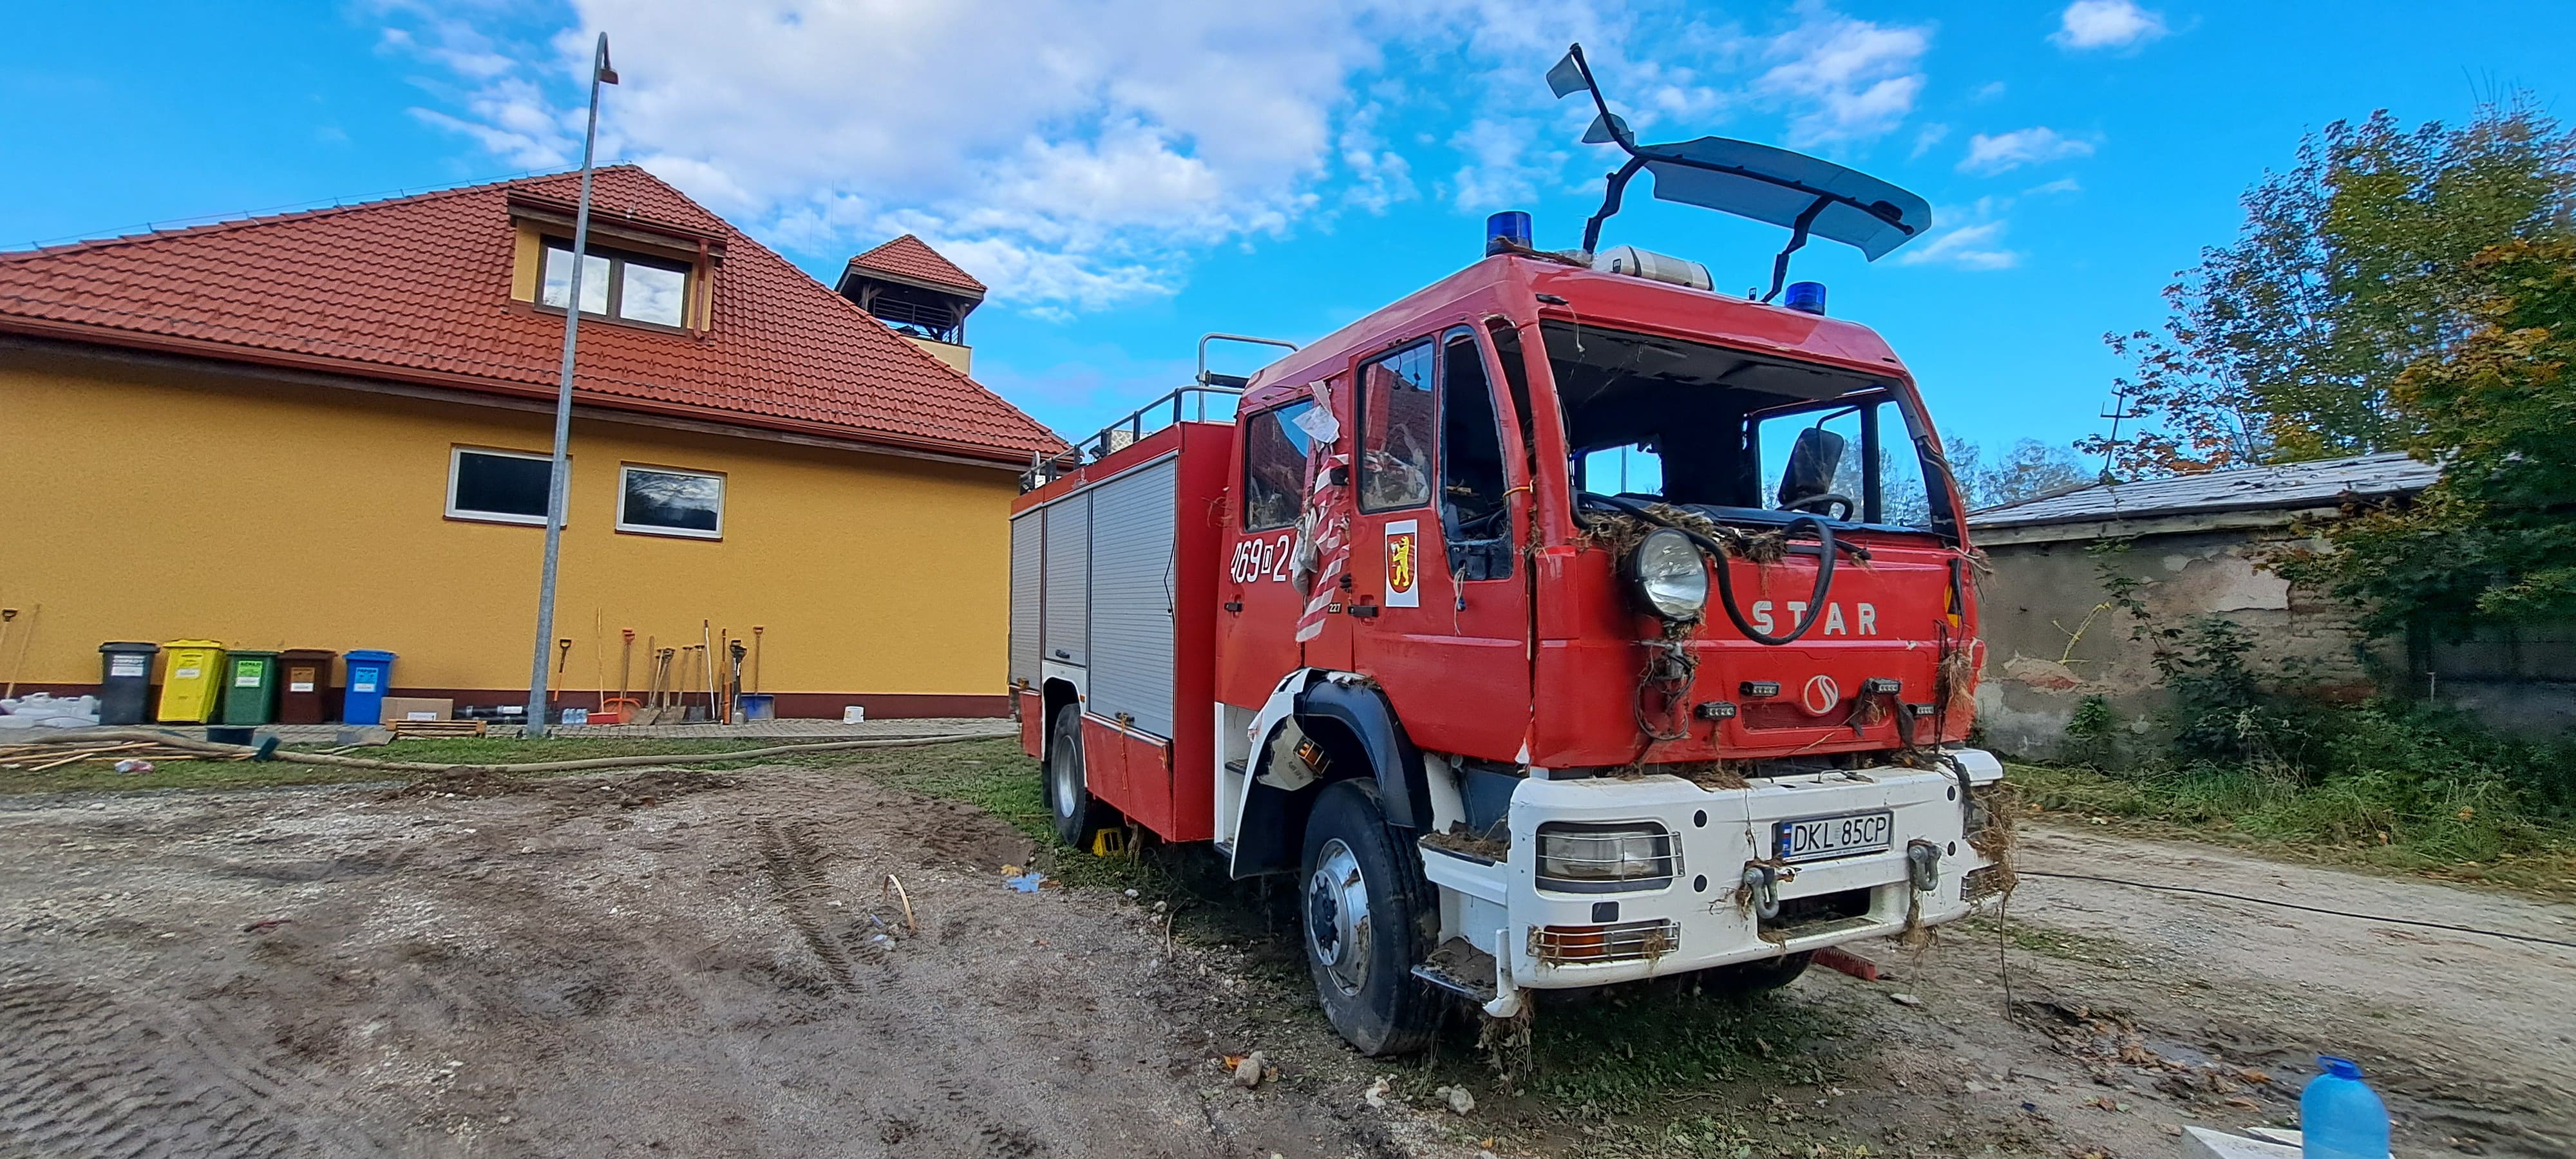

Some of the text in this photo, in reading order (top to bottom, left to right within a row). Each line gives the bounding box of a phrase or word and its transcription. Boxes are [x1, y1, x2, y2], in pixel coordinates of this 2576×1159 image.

[1231, 538, 1264, 583] 469
[1329, 603, 1341, 612] 227
[1752, 600, 1877, 636] STAR
[1794, 816, 1887, 852] DKL 85CP
